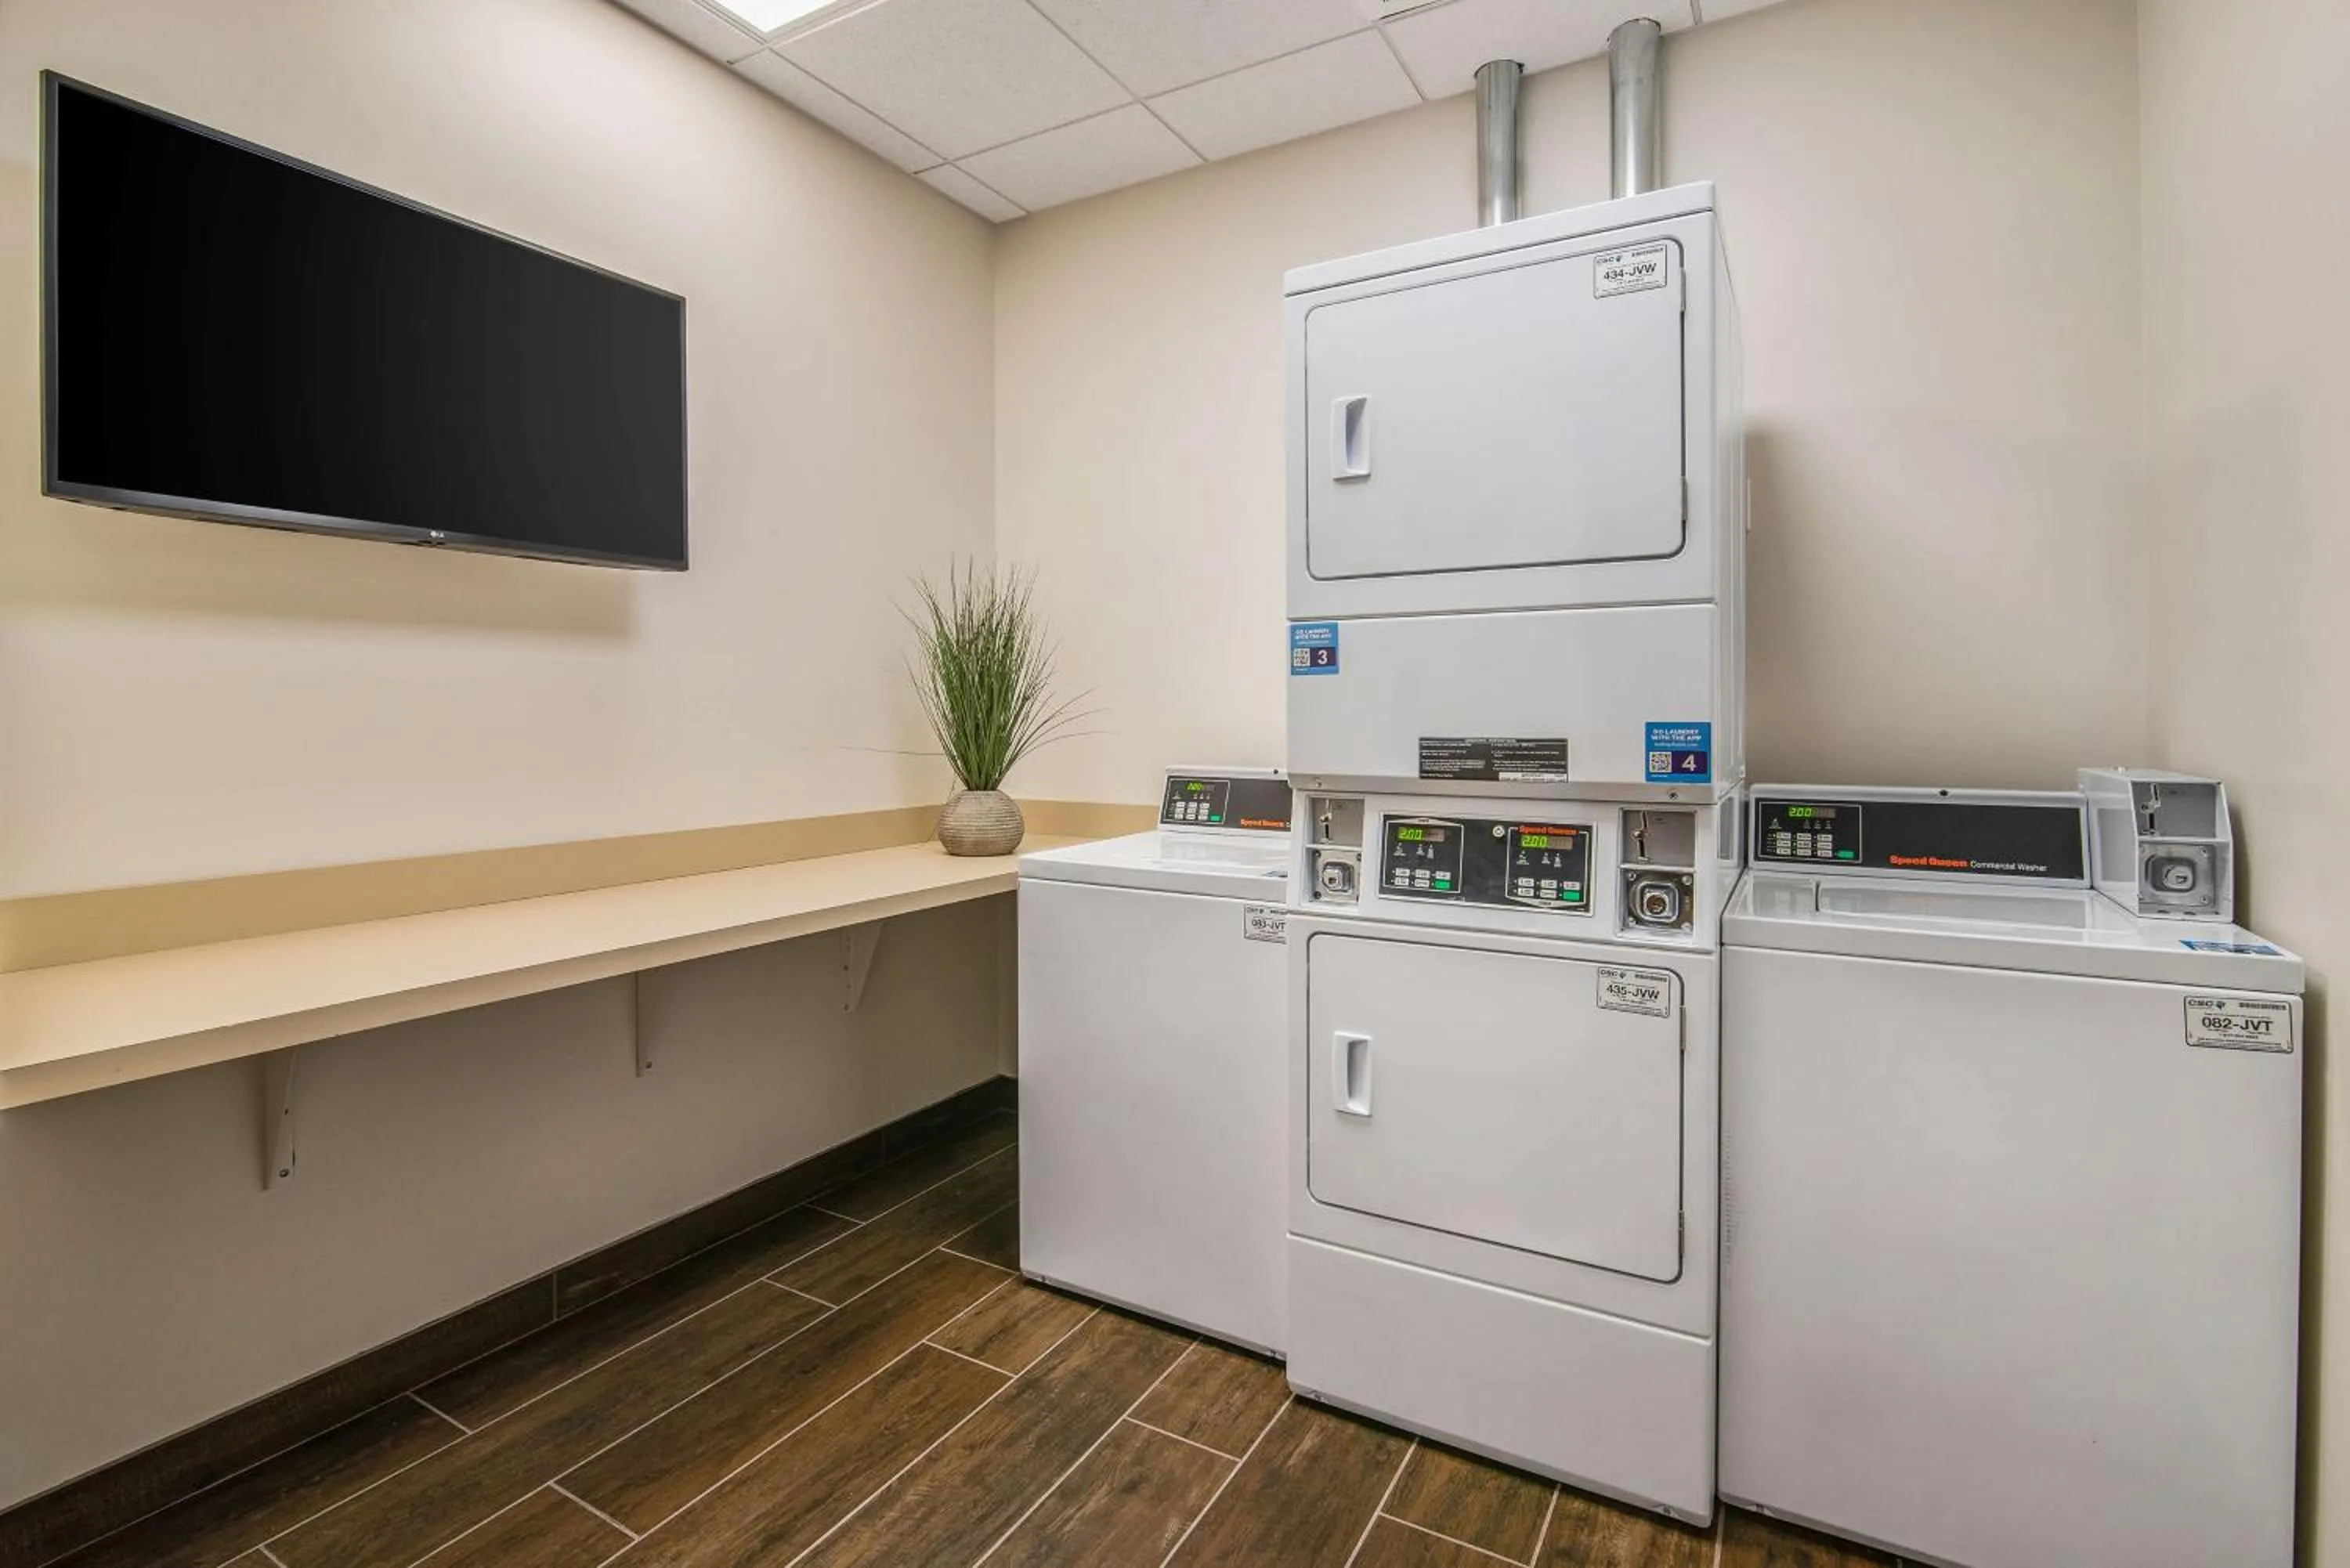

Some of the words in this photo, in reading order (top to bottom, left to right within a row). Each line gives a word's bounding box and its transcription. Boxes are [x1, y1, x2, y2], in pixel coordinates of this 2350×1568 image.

[1318, 649, 1328, 665] 3
[1682, 753, 1697, 772] 4
[1889, 854, 1927, 865] Speed
[1929, 857, 1969, 868] Queen
[1970, 861, 2016, 870] Commercial
[1607, 985, 1660, 999] 435-JVW
[2202, 1017, 2273, 1031] 082-JVT
